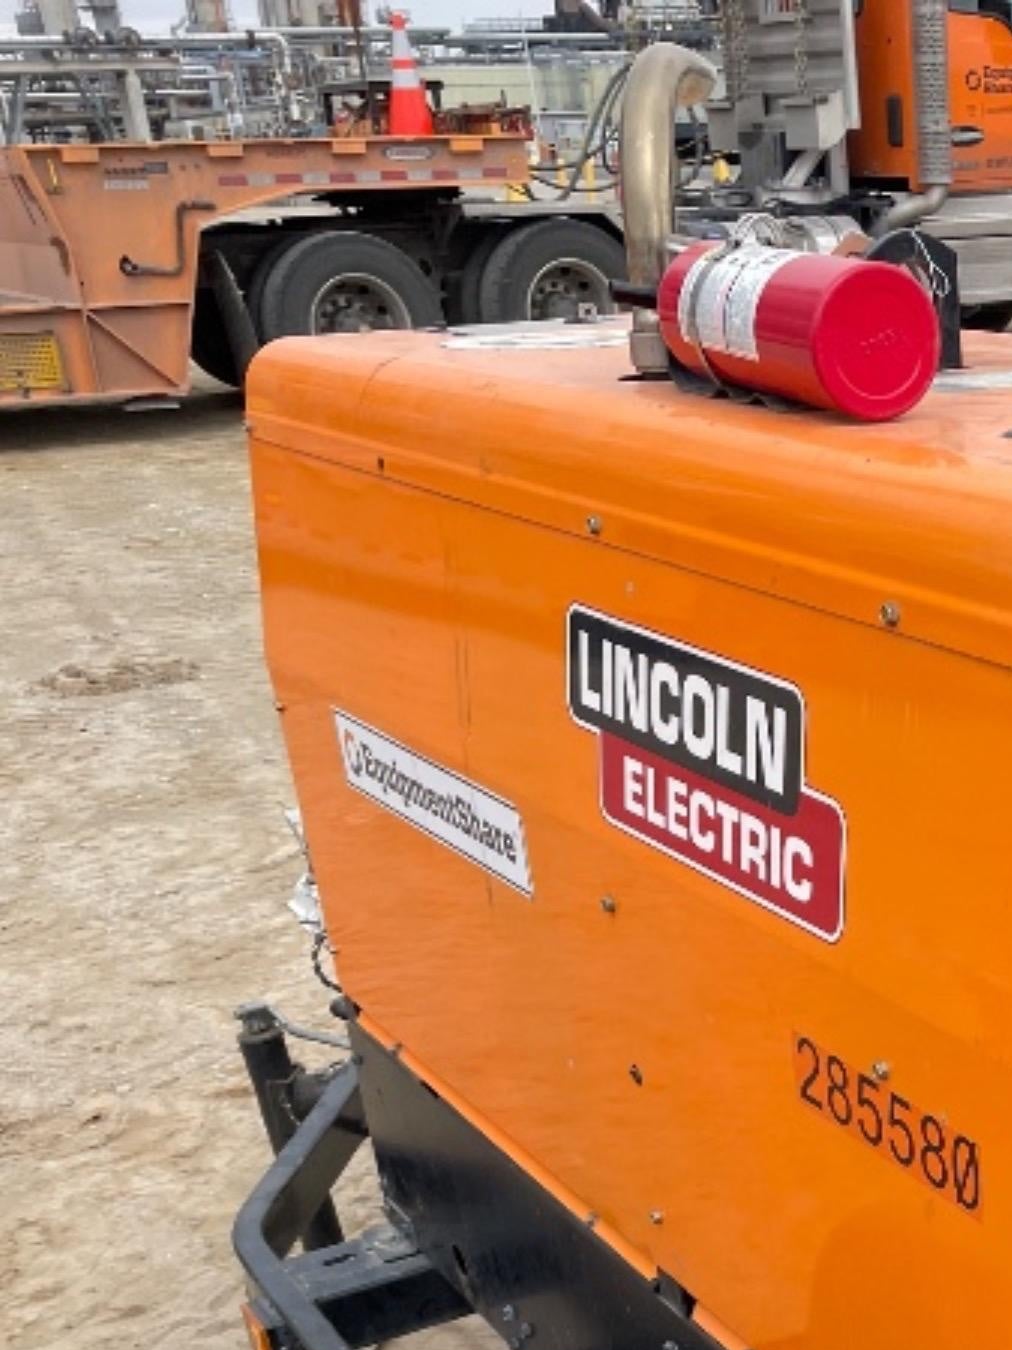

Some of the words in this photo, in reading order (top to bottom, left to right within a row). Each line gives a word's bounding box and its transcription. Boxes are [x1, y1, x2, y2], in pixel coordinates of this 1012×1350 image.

[577, 629, 787, 797] LINCOLN
[360, 741, 518, 865] EquipmentShare
[622, 755, 815, 904] ELECTRIC
